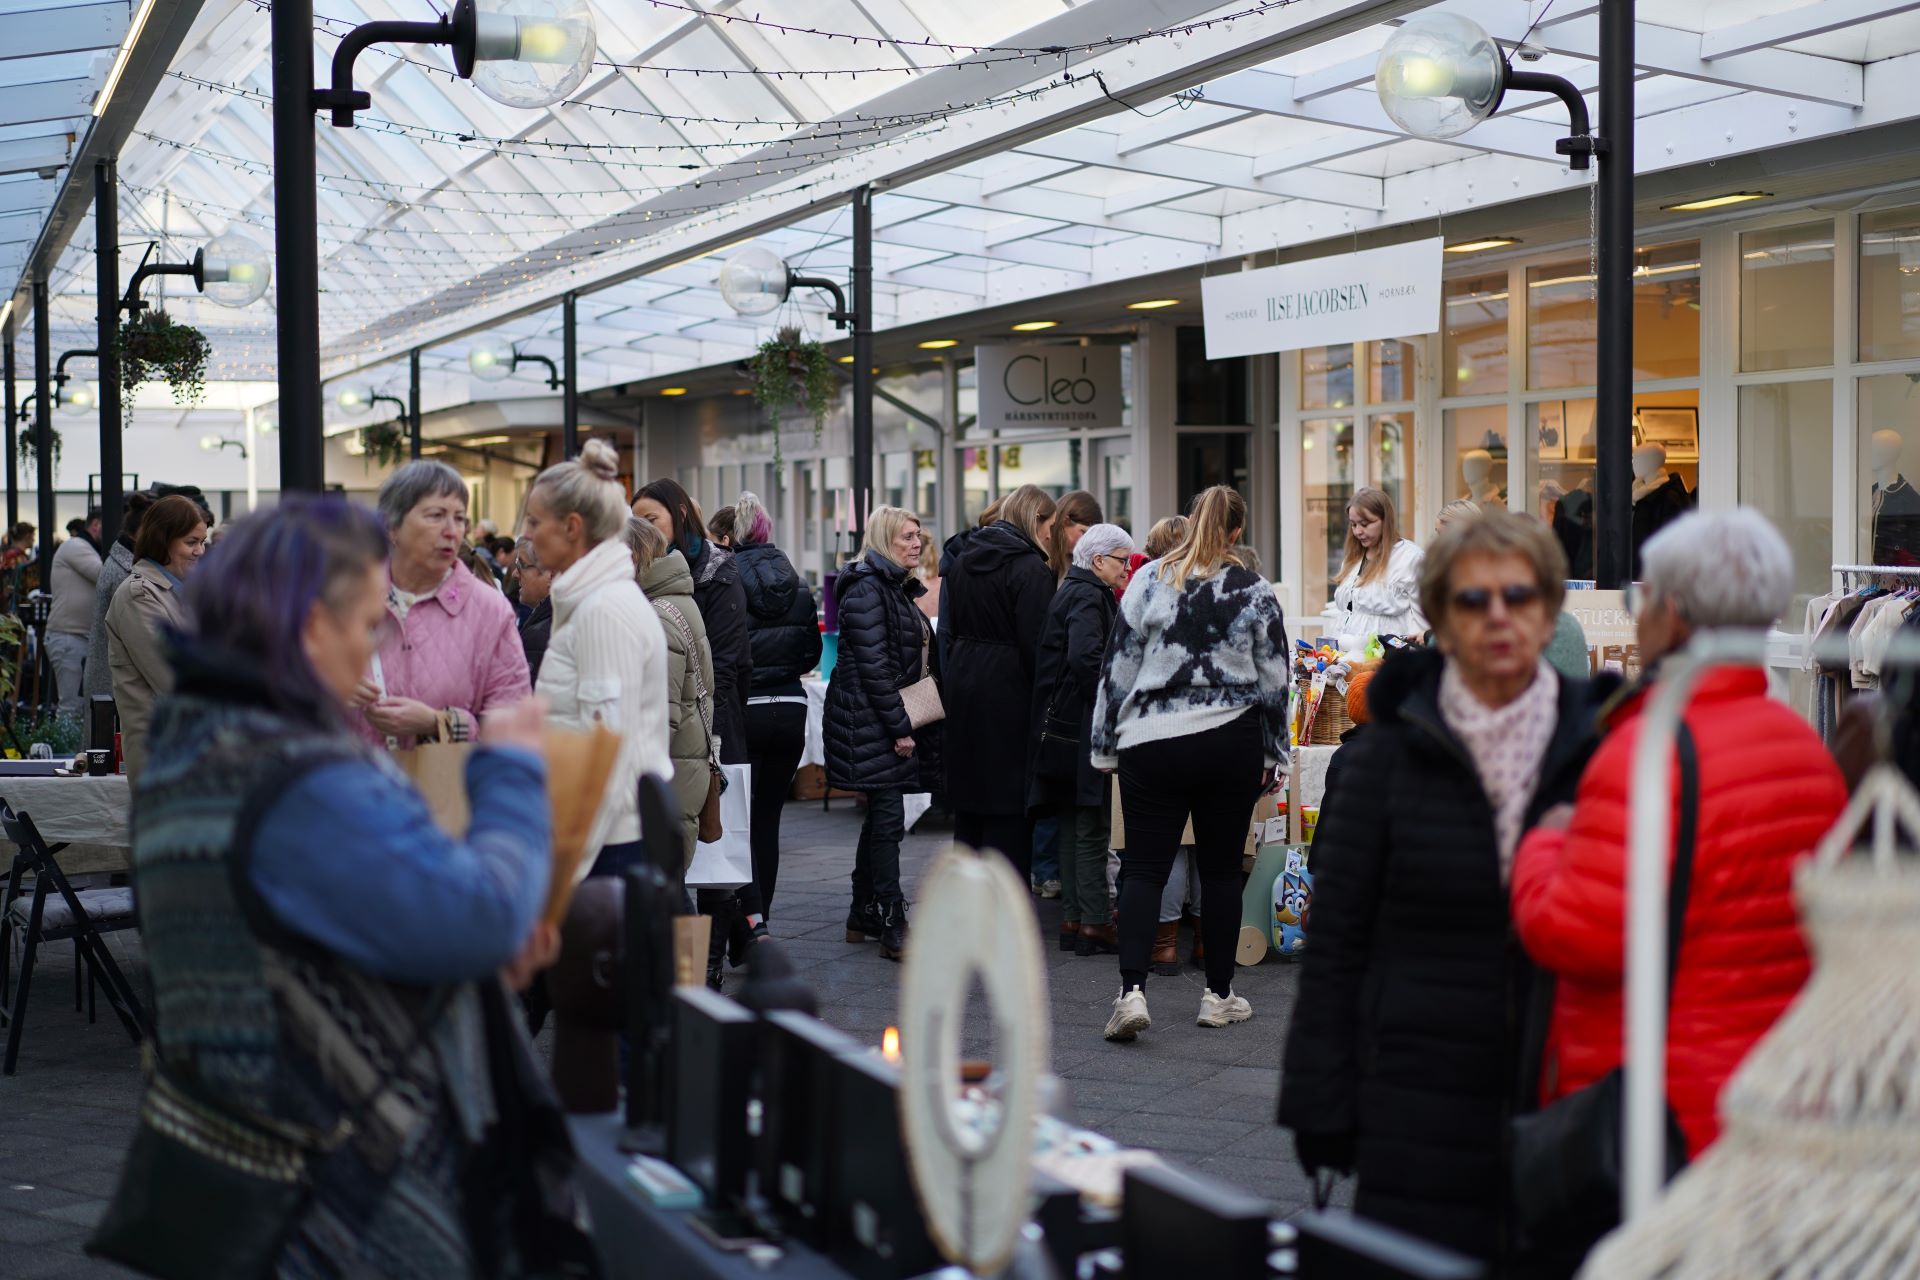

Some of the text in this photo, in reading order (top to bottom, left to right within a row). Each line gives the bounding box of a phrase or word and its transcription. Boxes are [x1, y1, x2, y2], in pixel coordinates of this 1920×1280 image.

[1267, 294, 1293, 322] ILSE
[1296, 283, 1369, 320] JACOBSEN
[1378, 284, 1417, 299] HORNBÆK
